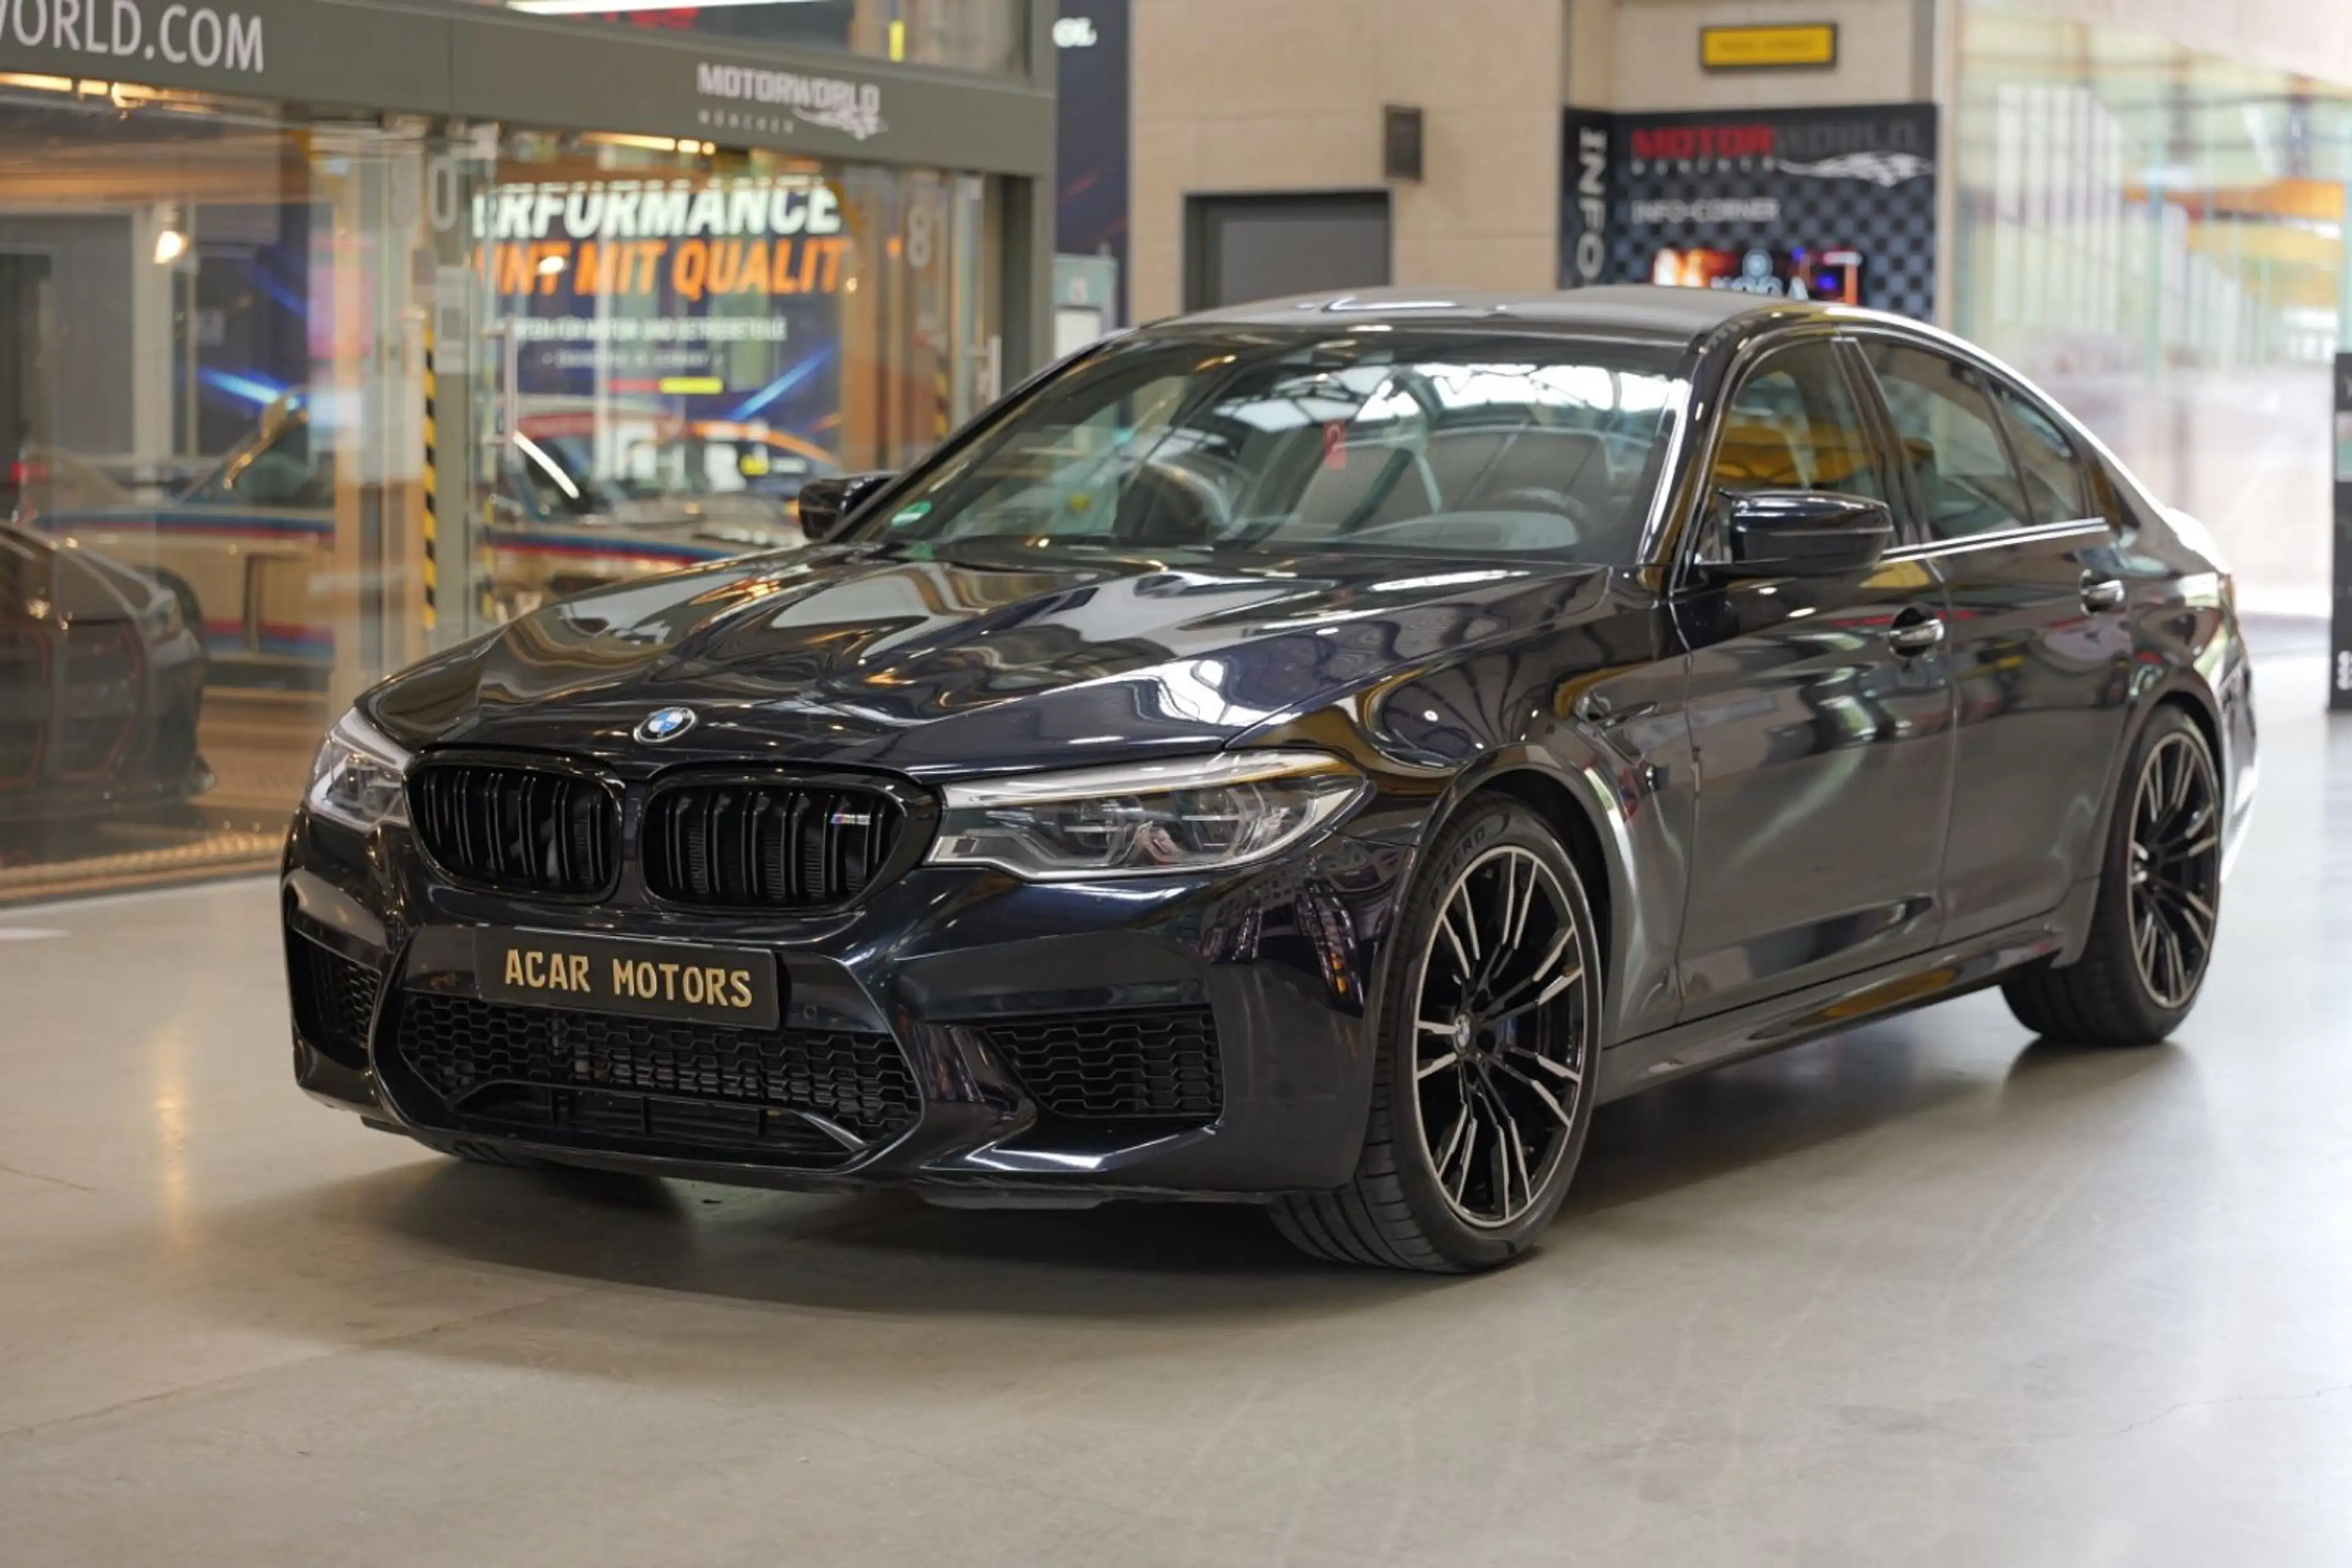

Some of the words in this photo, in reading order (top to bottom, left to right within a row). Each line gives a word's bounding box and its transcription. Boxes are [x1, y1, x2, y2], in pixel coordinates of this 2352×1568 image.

[0, 0, 264, 73] ORLD.COM
[697, 62, 881, 115] MOTORWORLD
[504, 948, 591, 993] ACAR
[612, 957, 753, 1008] MOTORS
